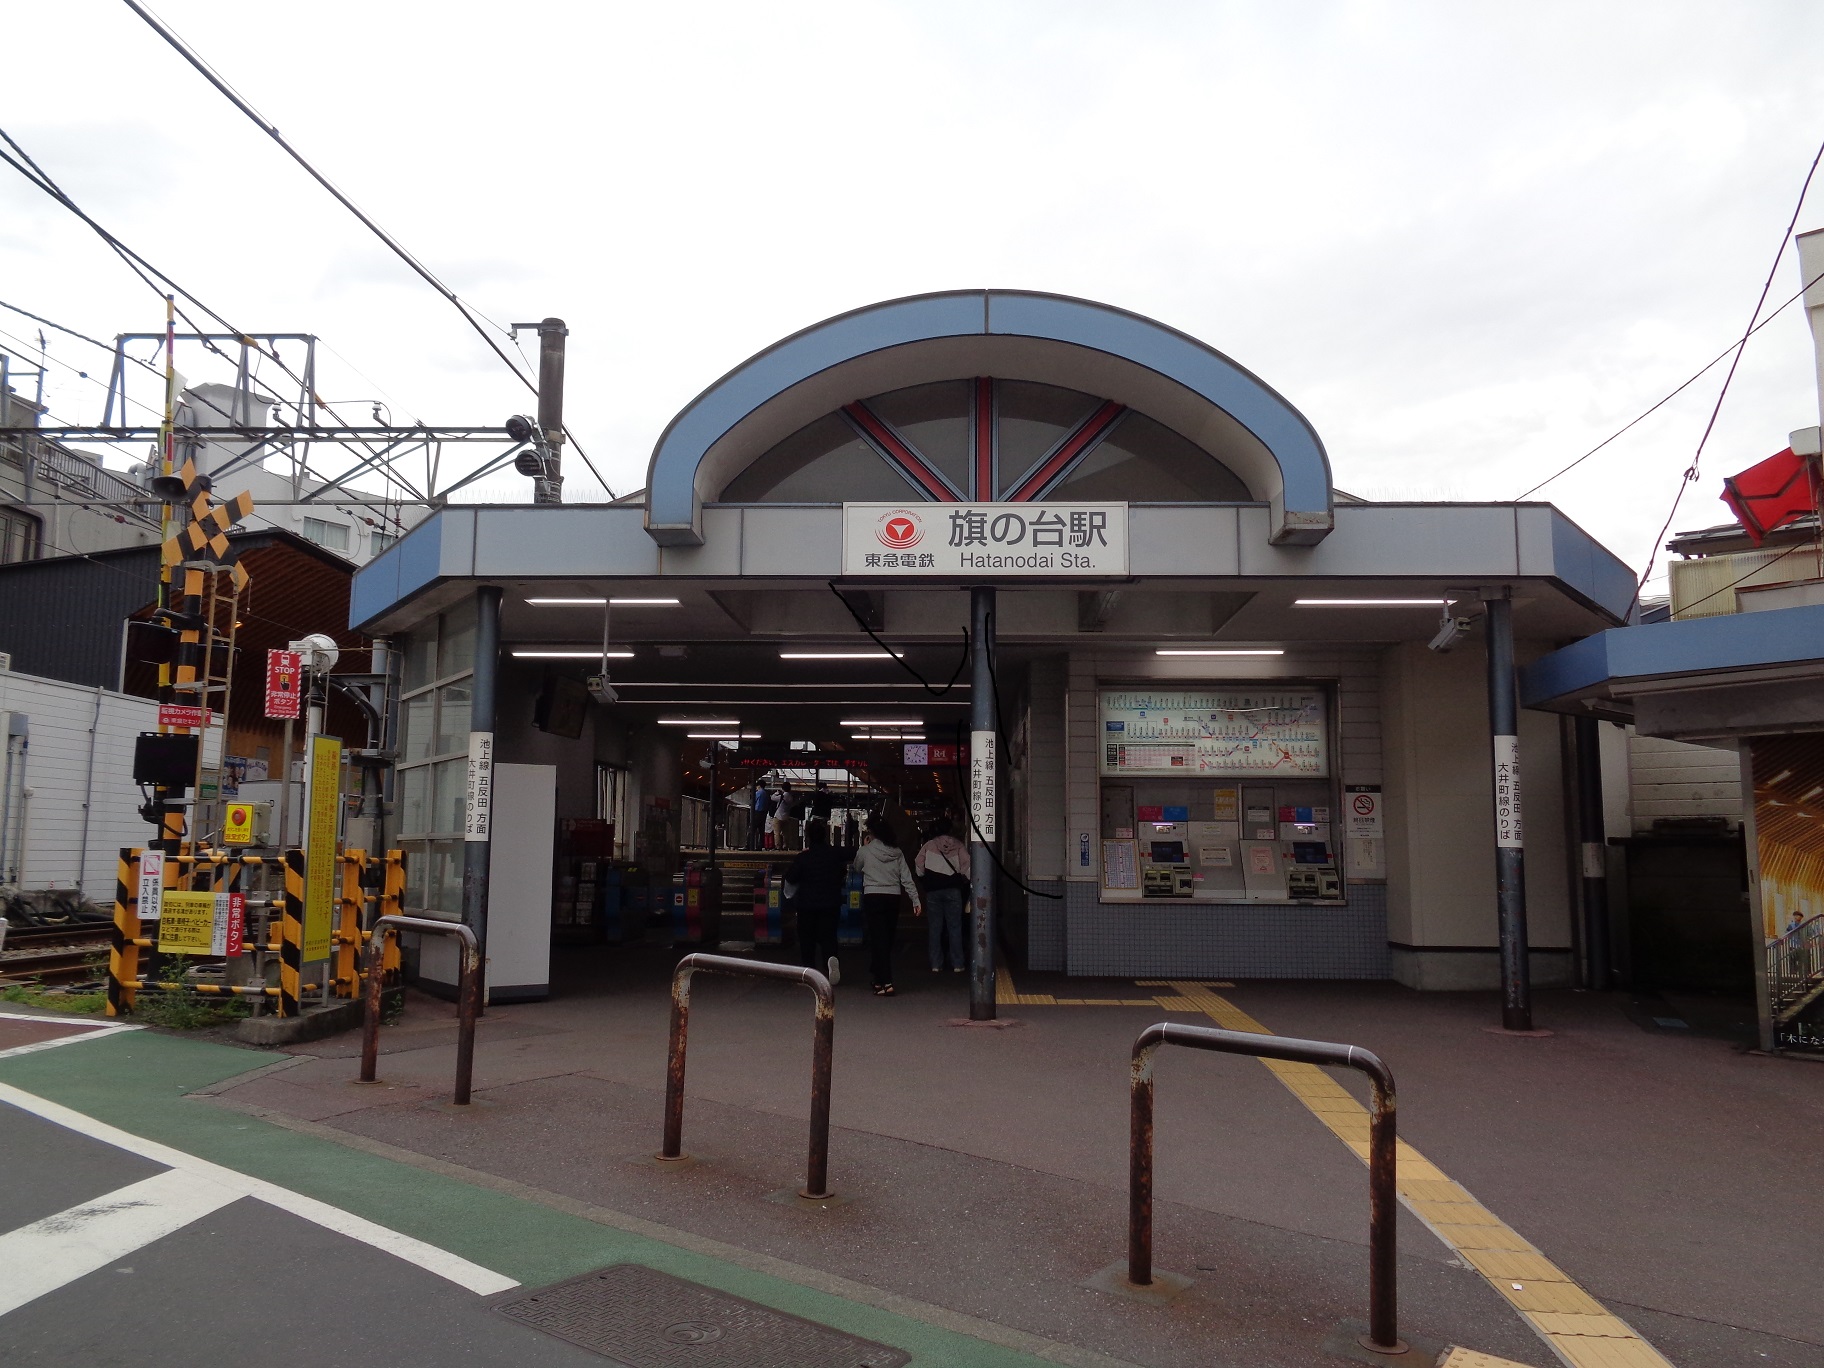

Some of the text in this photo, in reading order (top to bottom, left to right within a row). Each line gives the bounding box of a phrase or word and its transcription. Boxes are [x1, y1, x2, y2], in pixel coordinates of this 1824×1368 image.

[892, 509, 923, 524] CORPORATION
[948, 510, 1108, 548] 旗の台駅
[865, 553, 935, 568] 東急電鉄
[960, 552, 1096, 568] Hatanodai Sta.
[274, 666, 295, 674] STOP
[270, 691, 296, 699] 非常停止
[467, 759, 476, 833] 大井町線のりば
[476, 738, 491, 834] 池上線 五反田 方面
[985, 738, 994, 835] 池上線 五反田 方面
[1498, 762, 1510, 839] 大井町線のりば
[1512, 780, 1521, 813] 五反田
[225, 833, 249, 841] 非常ボタン
[1513, 819, 1522, 841] 方面
[141, 878, 149, 914] 立入禁止
[151, 878, 159, 914] 係員以外
[230, 897, 242, 952] 非常ボタン
[1781, 1033, 1824, 1045] 「木にな
